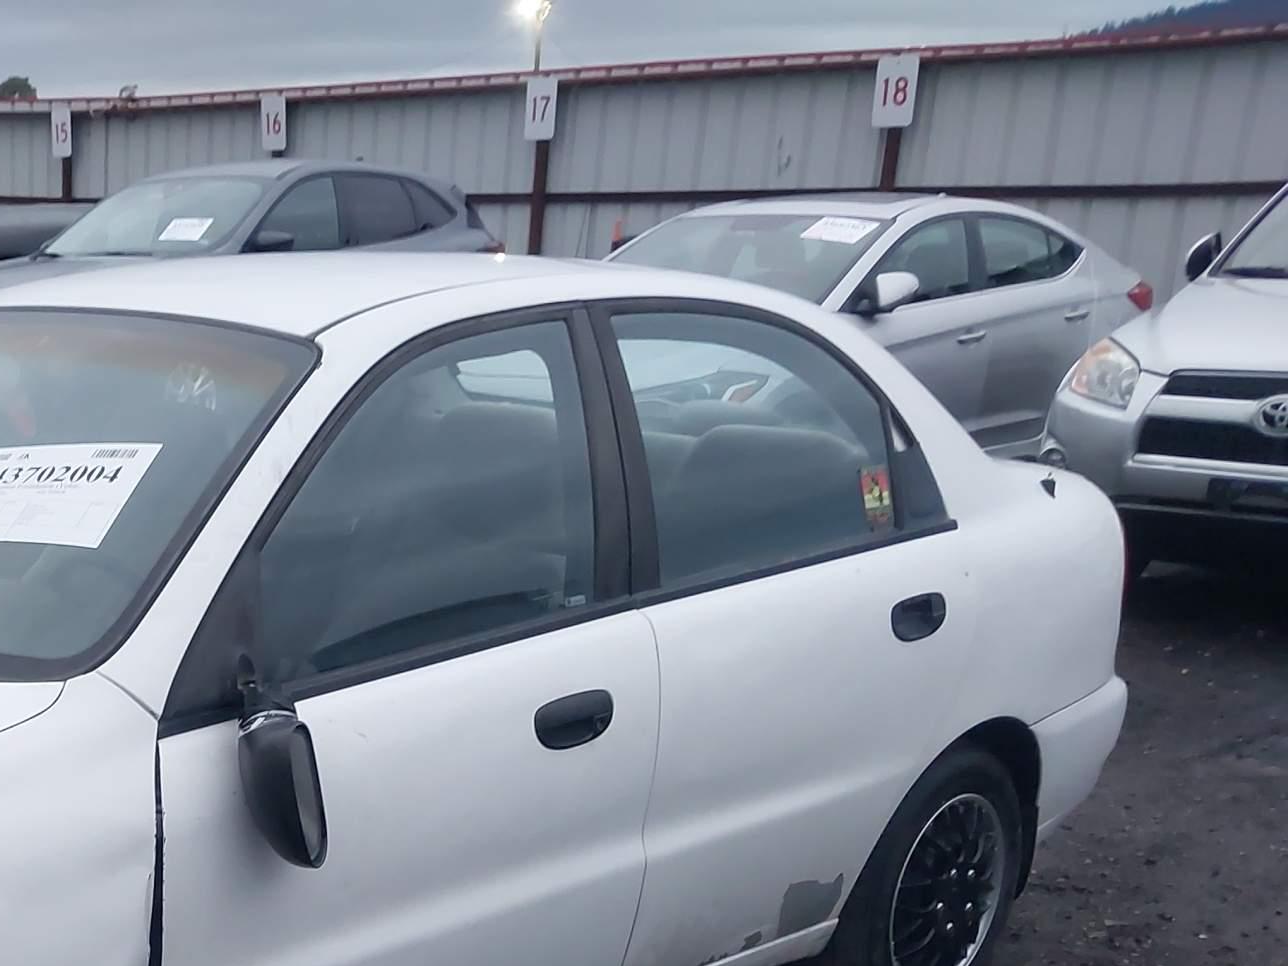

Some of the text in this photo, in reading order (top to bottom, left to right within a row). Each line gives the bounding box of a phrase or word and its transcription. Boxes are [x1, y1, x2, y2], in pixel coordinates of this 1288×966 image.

[882, 76, 908, 107] 18
[532, 95, 551, 122] 17
[55, 121, 68, 145] 15
[266, 111, 281, 136] 16
